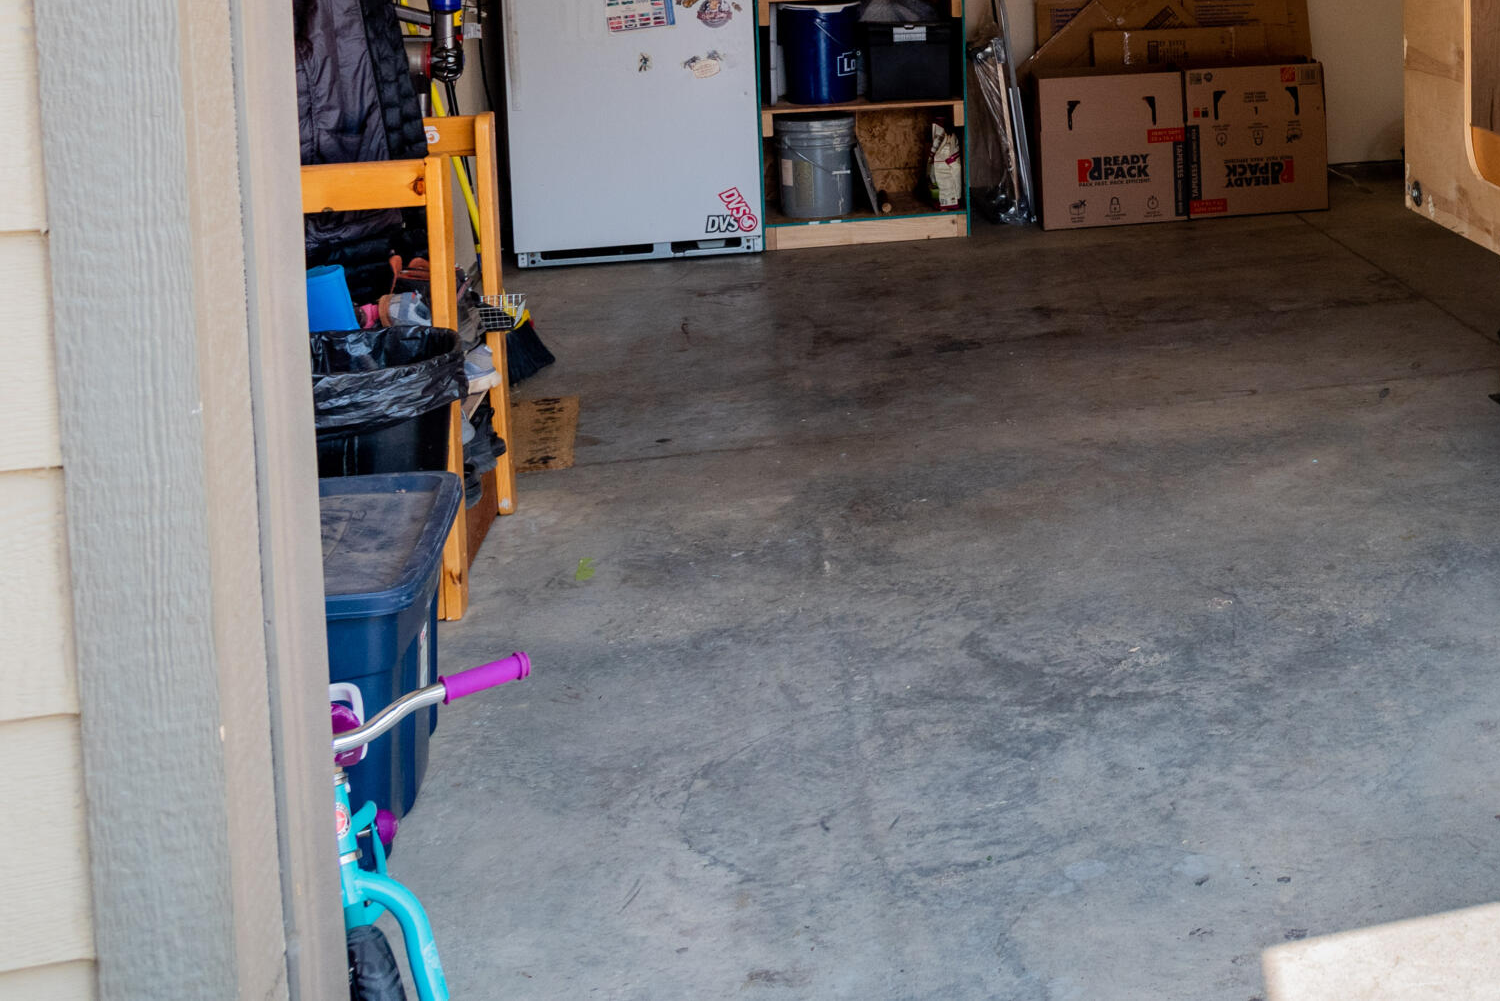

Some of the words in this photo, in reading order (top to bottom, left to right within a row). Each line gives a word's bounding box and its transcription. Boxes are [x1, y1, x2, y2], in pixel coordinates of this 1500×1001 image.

[1104, 153, 1150, 166] READY
[1104, 164, 1150, 180] PACK
[1224, 162, 1269, 177] PACK
[1224, 176, 1269, 188] READY
[718, 187, 751, 218] DVS
[705, 215, 740, 233] DVS
